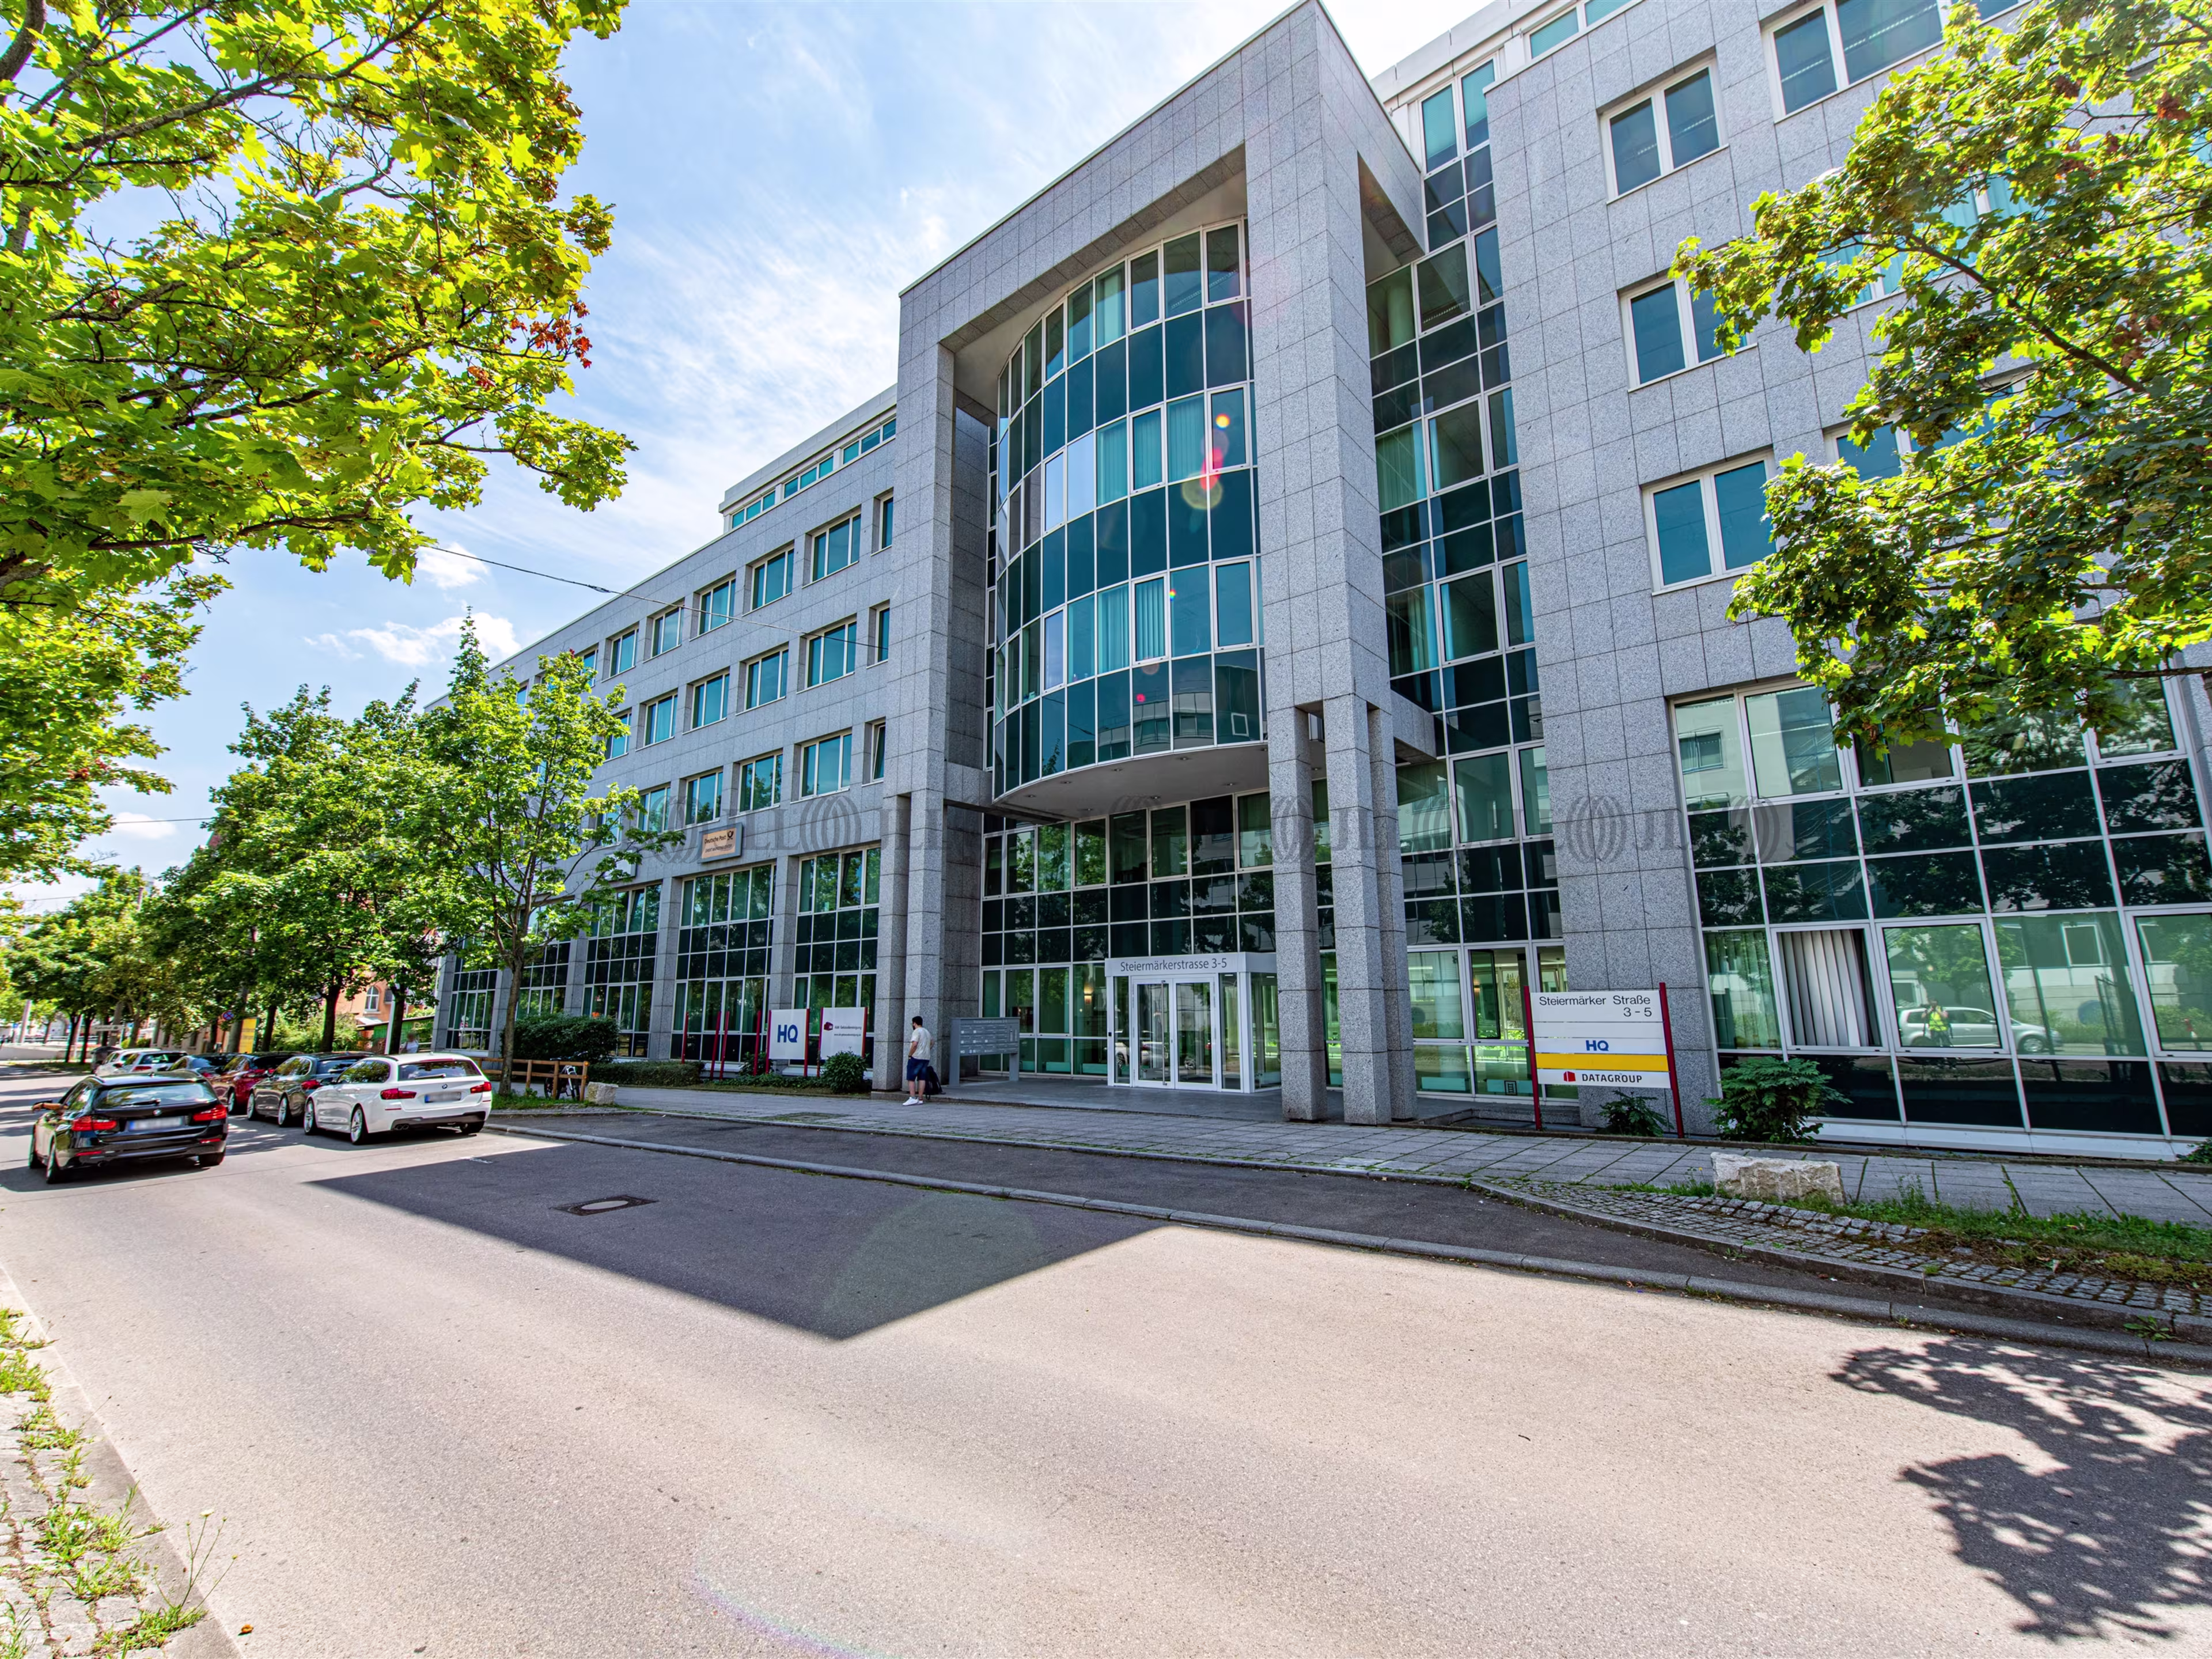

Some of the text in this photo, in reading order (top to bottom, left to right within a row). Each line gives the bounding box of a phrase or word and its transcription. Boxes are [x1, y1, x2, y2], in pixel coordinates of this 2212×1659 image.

[1120, 957, 1227, 972] Steiermärkerstrasse 3-5
[1539, 995, 1651, 1006] Steiermärker Straße
[777, 1024, 798, 1043] HQ
[1585, 1040, 1609, 1051] HQ
[1582, 1074, 1642, 1083] DATAGROUP
